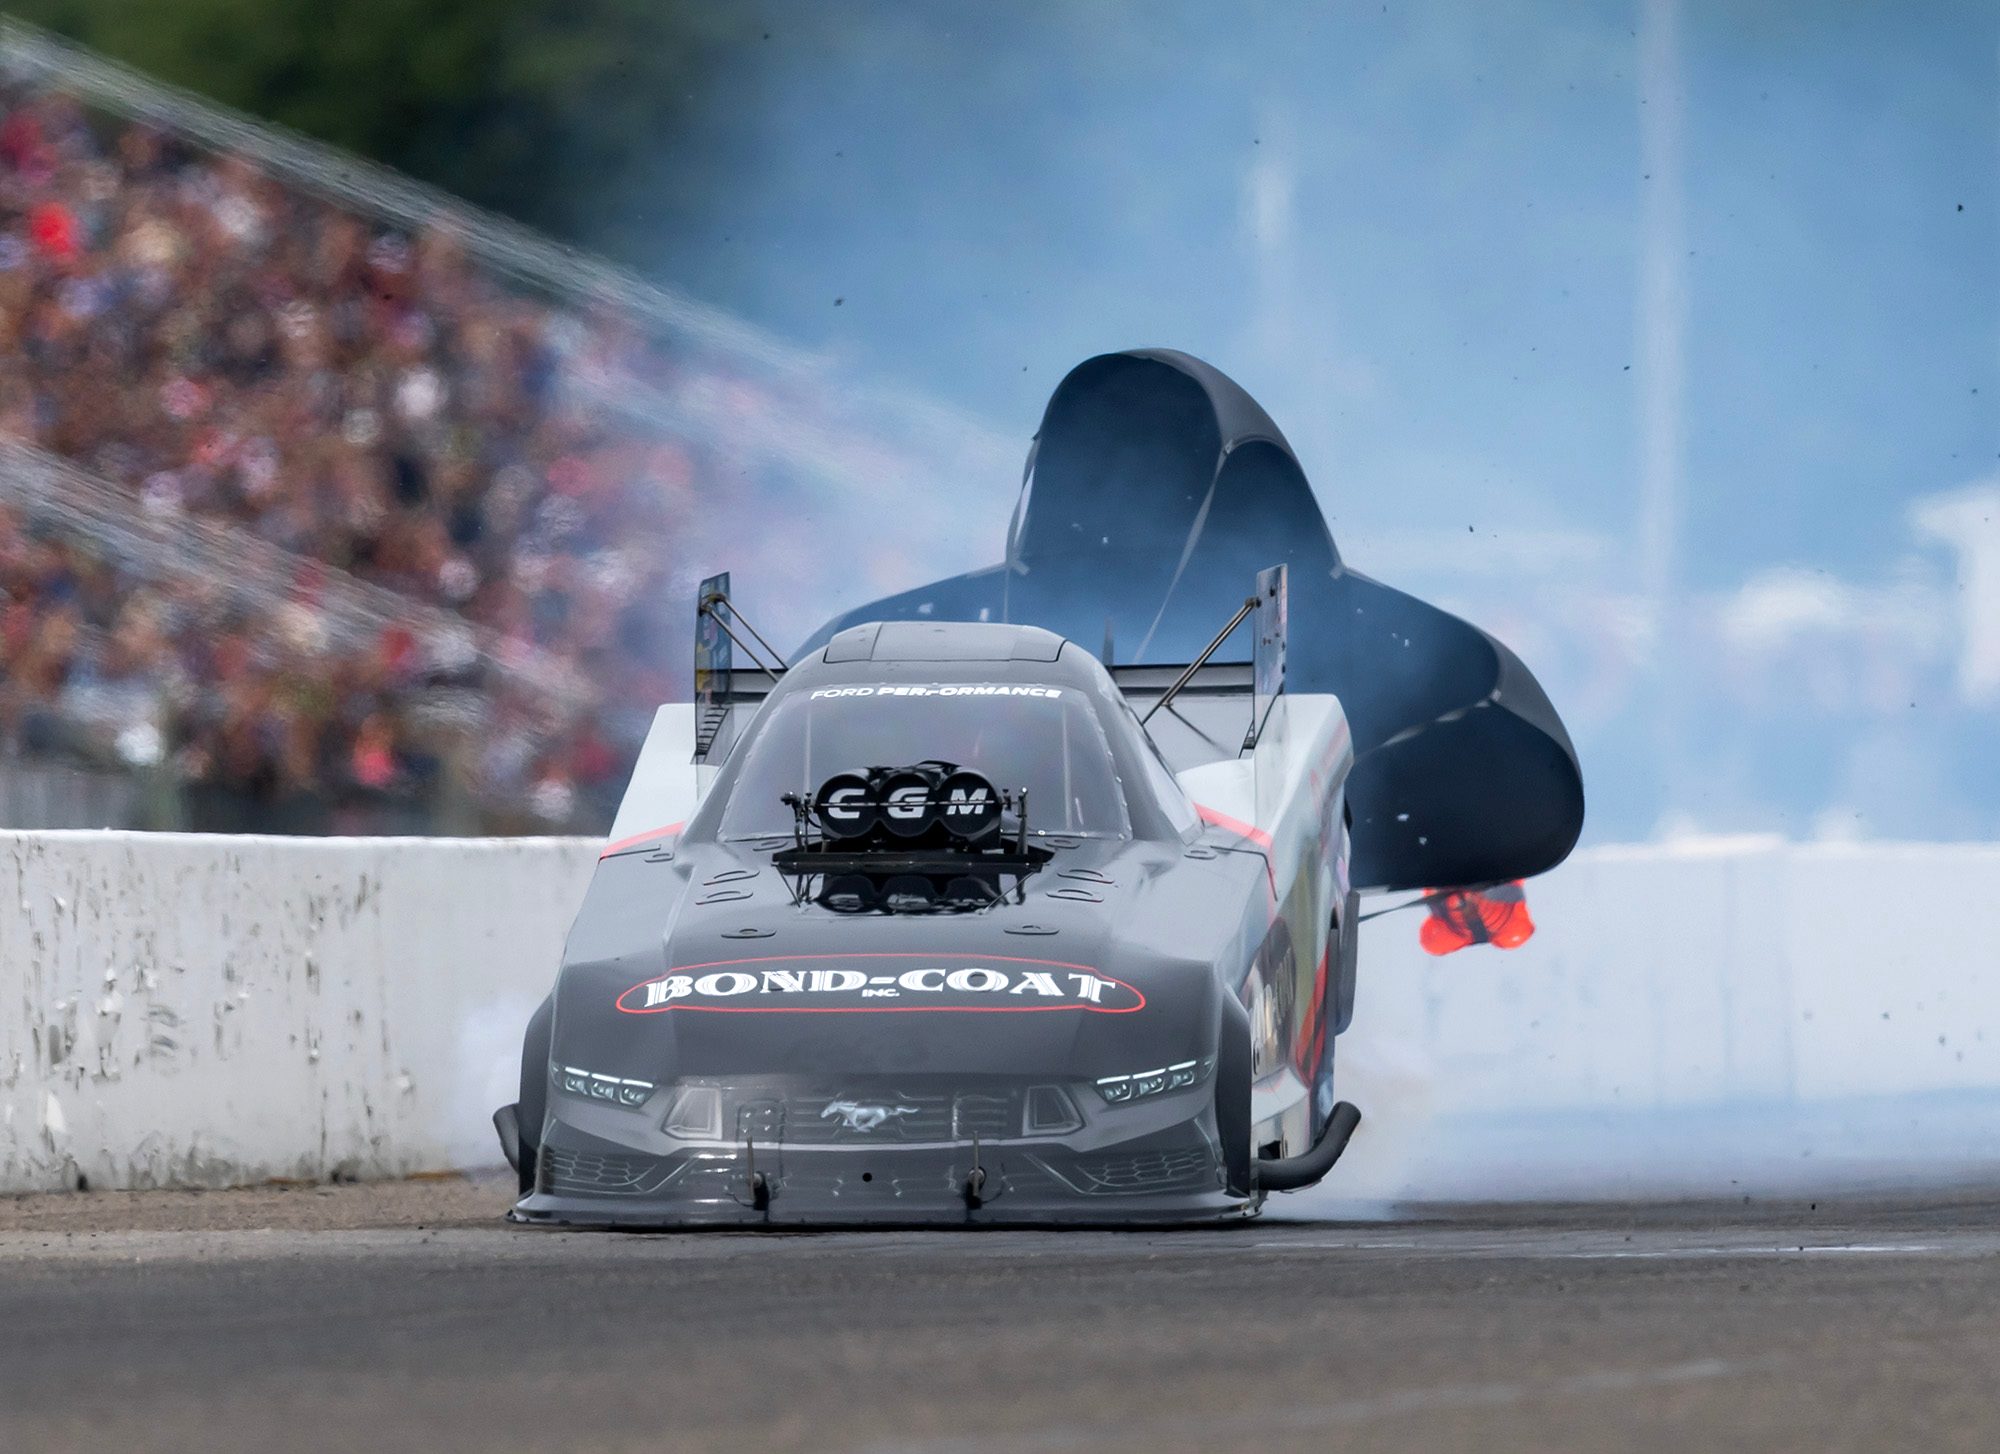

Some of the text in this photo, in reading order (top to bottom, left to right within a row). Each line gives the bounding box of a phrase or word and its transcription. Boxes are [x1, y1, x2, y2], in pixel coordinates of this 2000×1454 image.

[810, 686, 1062, 700] FORD PERFORMANCE
[644, 967, 1117, 1008] BOND-COAT
[861, 988, 900, 998] INC.
